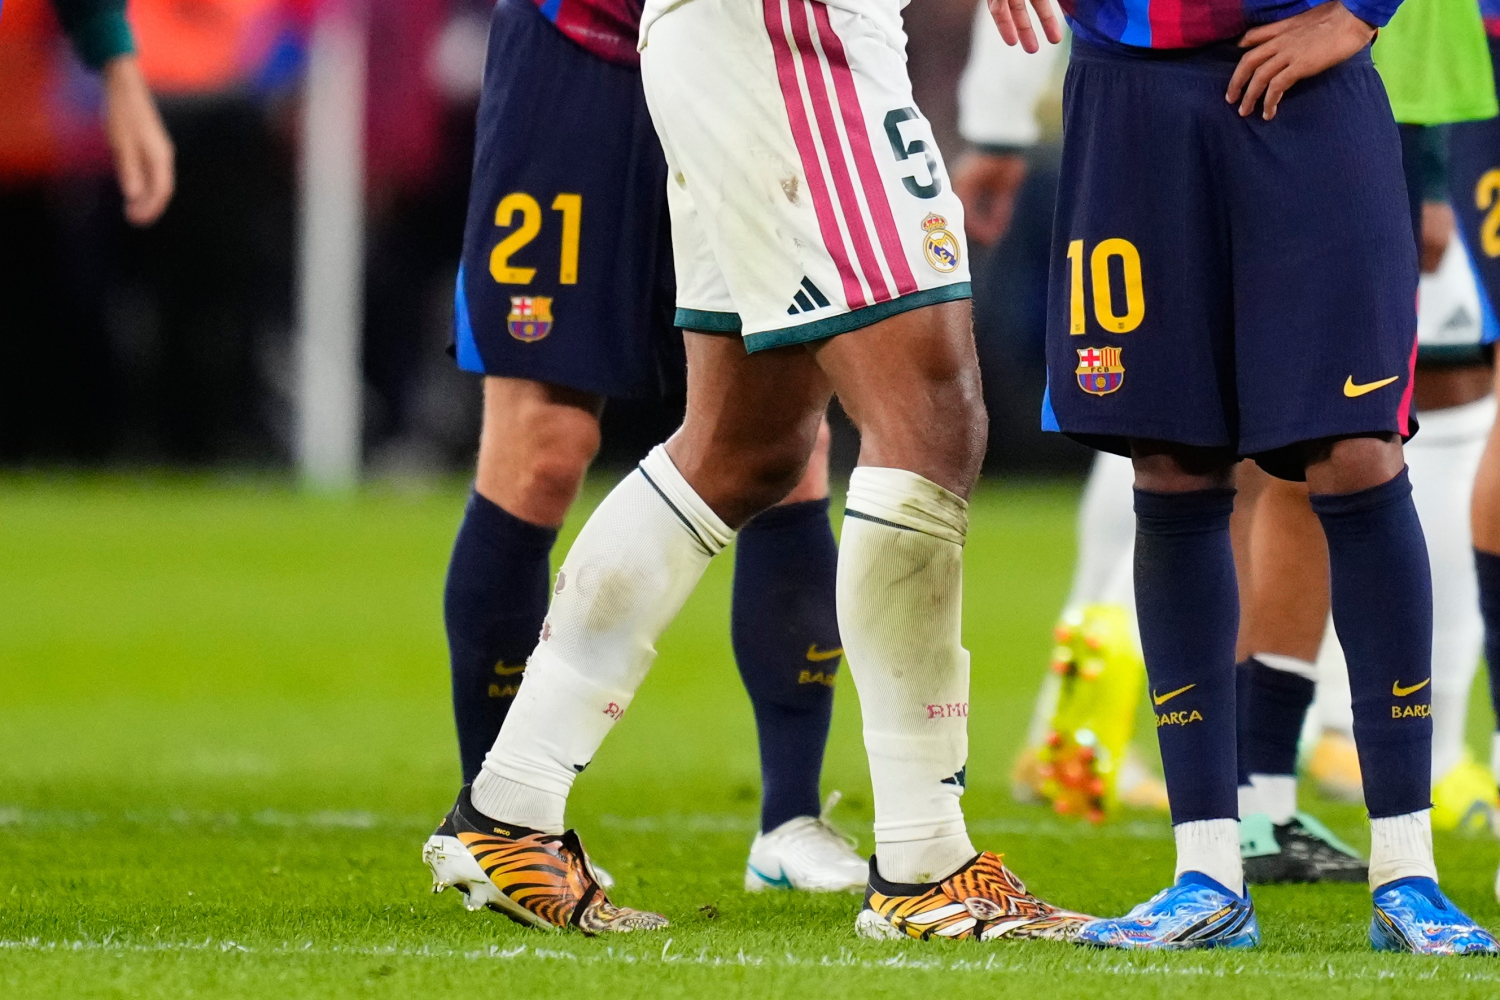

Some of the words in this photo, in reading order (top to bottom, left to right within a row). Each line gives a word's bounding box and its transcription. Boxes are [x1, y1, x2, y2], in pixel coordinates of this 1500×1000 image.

[883, 106, 942, 199] 5
[489, 192, 582, 285] 21
[1066, 238, 1145, 335] 10
[1090, 366, 1110, 374] FCB
